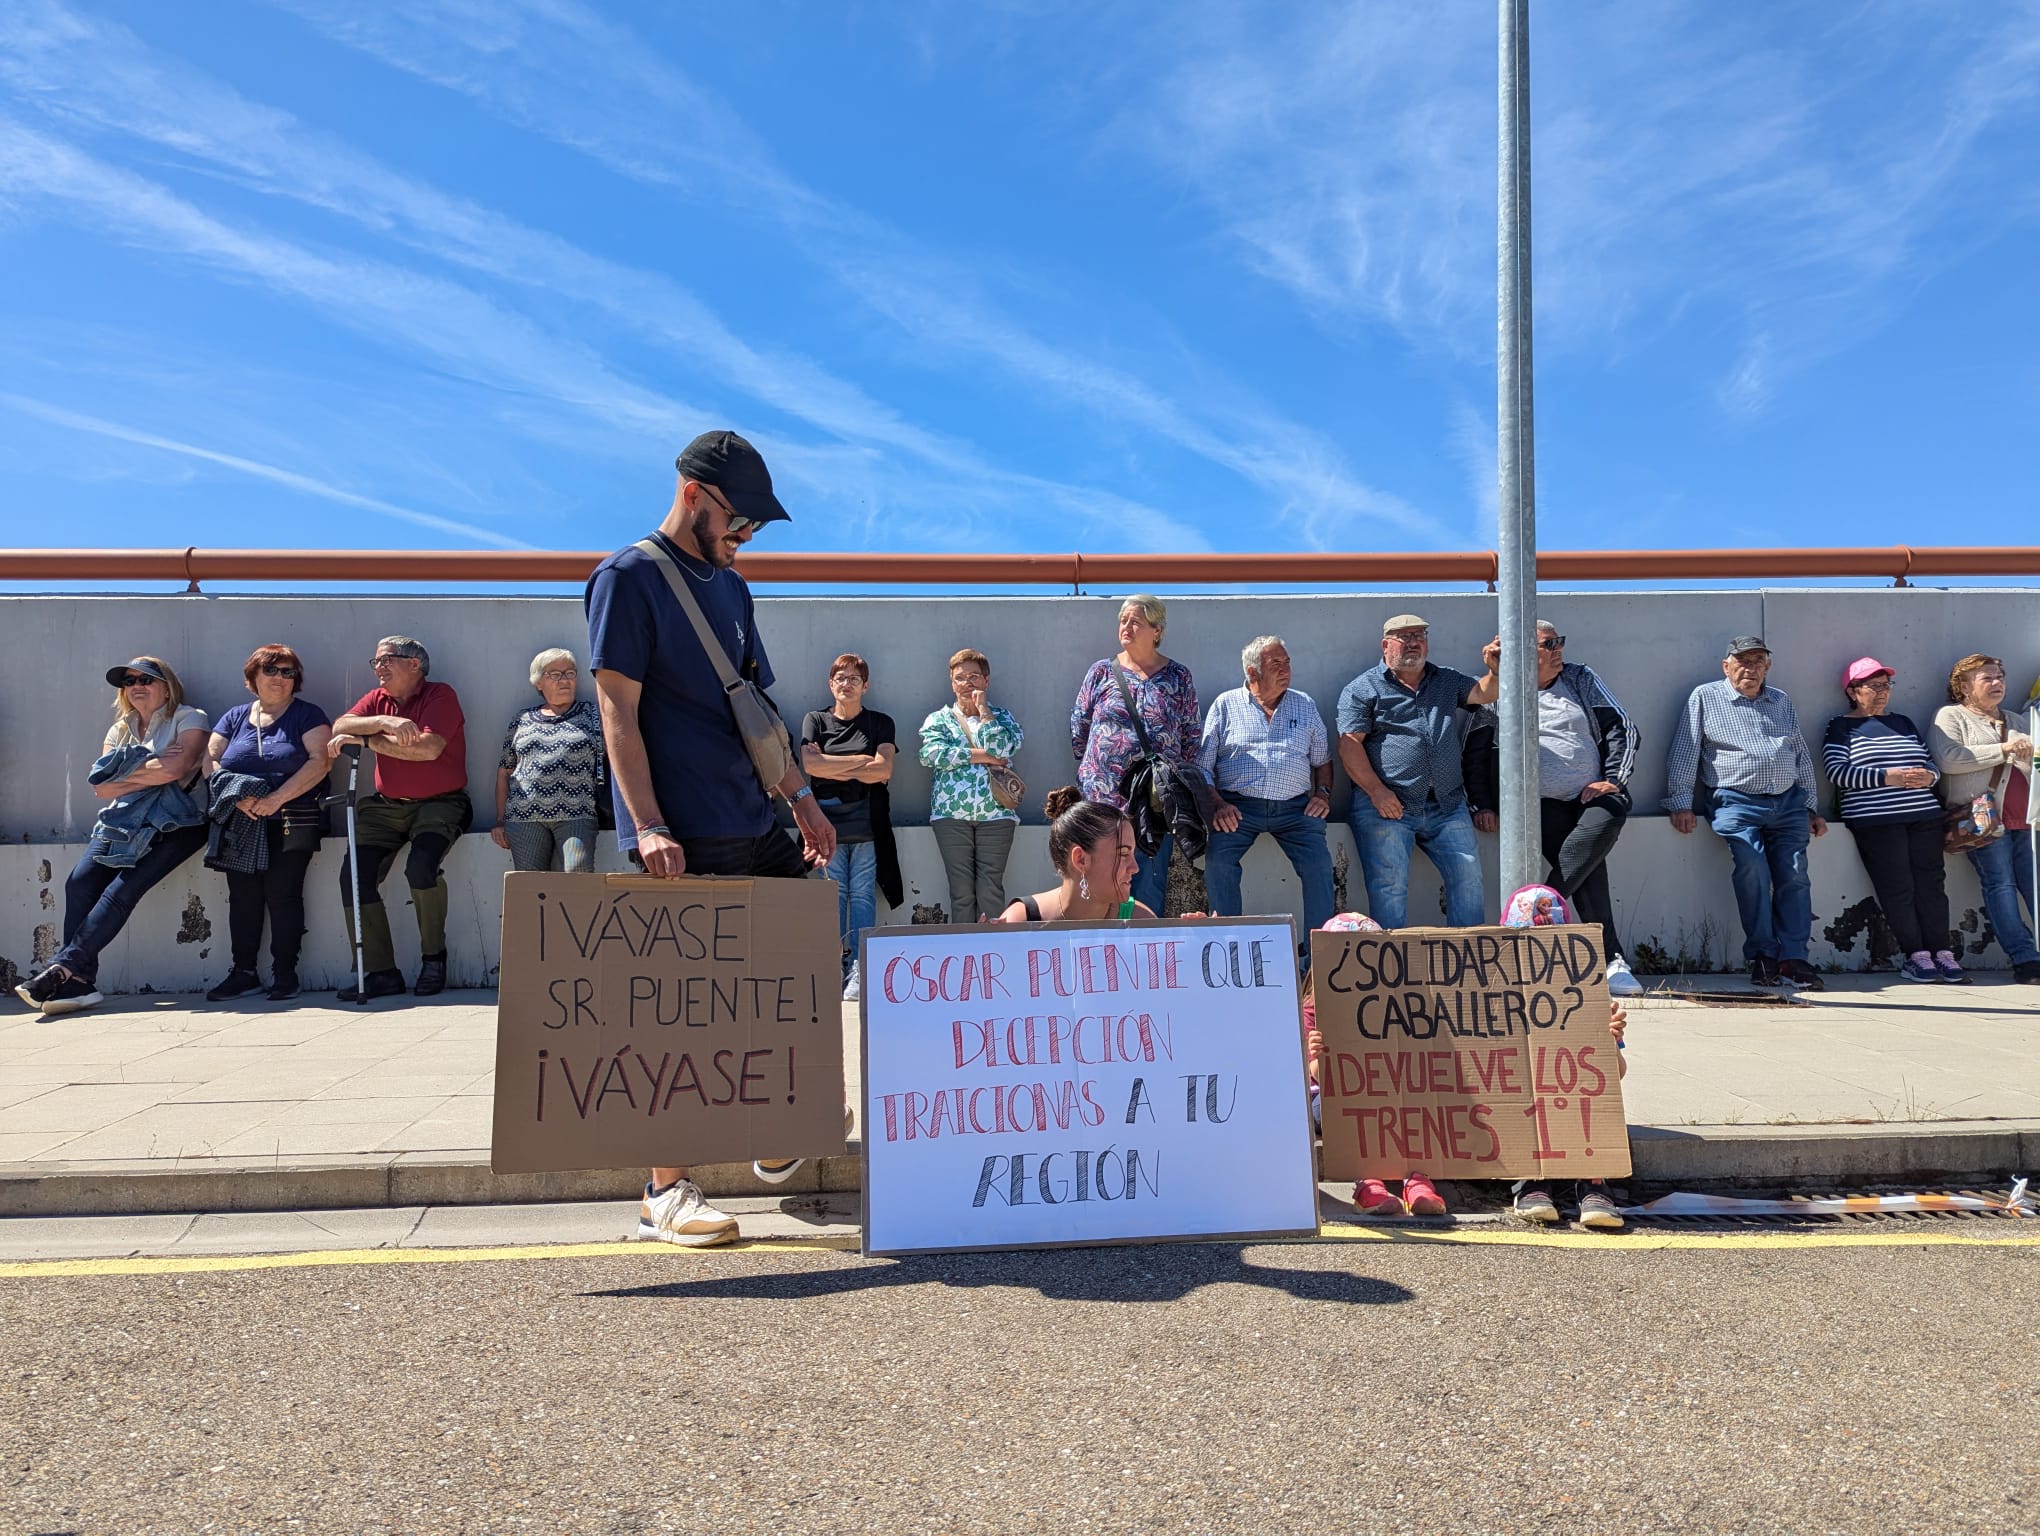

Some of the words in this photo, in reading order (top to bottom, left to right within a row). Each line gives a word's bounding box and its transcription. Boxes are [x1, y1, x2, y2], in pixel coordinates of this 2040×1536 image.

[538, 892, 746, 962] ¡VÁYASE
[884, 950, 1012, 1004] ÓSCAR
[1027, 940, 1190, 998] PUENTE
[1201, 935, 1283, 990] QUÉ
[1328, 933, 1605, 993] ¿SOLIDARIDAD,
[543, 977, 607, 1030] SR.
[630, 974, 819, 1028] PUENTE!
[1357, 986, 1584, 1040] CABALLERO?
[952, 1009, 1174, 1070] DECEPCIÓN
[536, 1044, 797, 1122] ¡VÁYASE!
[1323, 1046, 1523, 1098] ¡DEVUELVE
[1535, 1046, 1607, 1097] LOS
[875, 1079, 1106, 1142] TRAICIONAS
[1125, 1077, 1156, 1125] A
[1178, 1073, 1238, 1124] TU
[1342, 1103, 1501, 1163] TRENES
[972, 1143, 1161, 1208] REGIÓN
